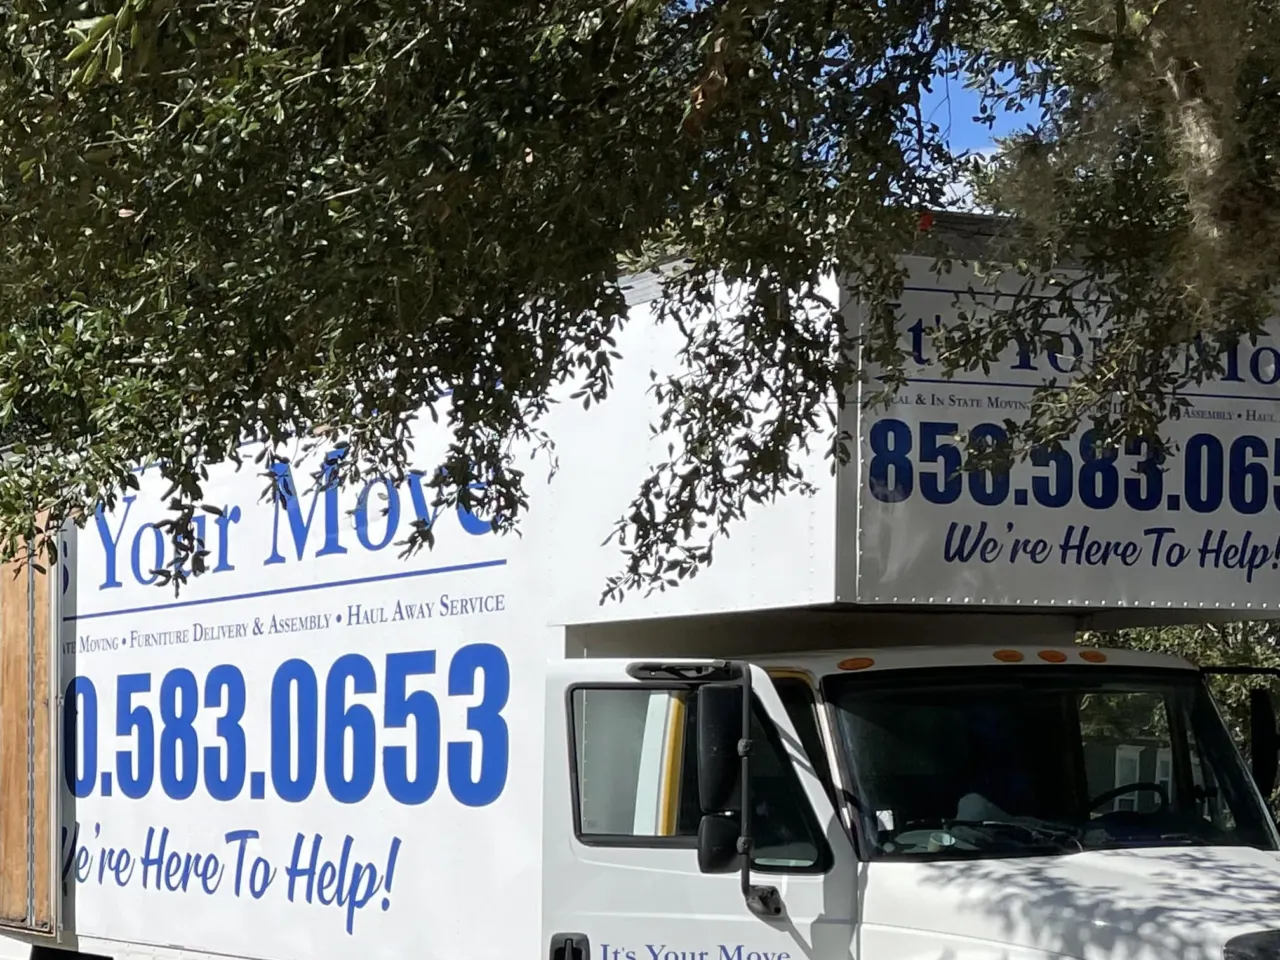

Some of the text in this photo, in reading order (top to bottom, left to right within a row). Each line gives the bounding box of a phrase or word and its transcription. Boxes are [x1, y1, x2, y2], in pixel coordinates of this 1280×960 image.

[915, 395, 927, 406] &
[869, 418, 1280, 515] 850.583.06
[943, 520, 1280, 584] We're Here To Help!
[252, 617, 265, 636] &
[140, 826, 225, 895] Here
[225, 829, 277, 899] To
[285, 831, 402, 936] Help!
